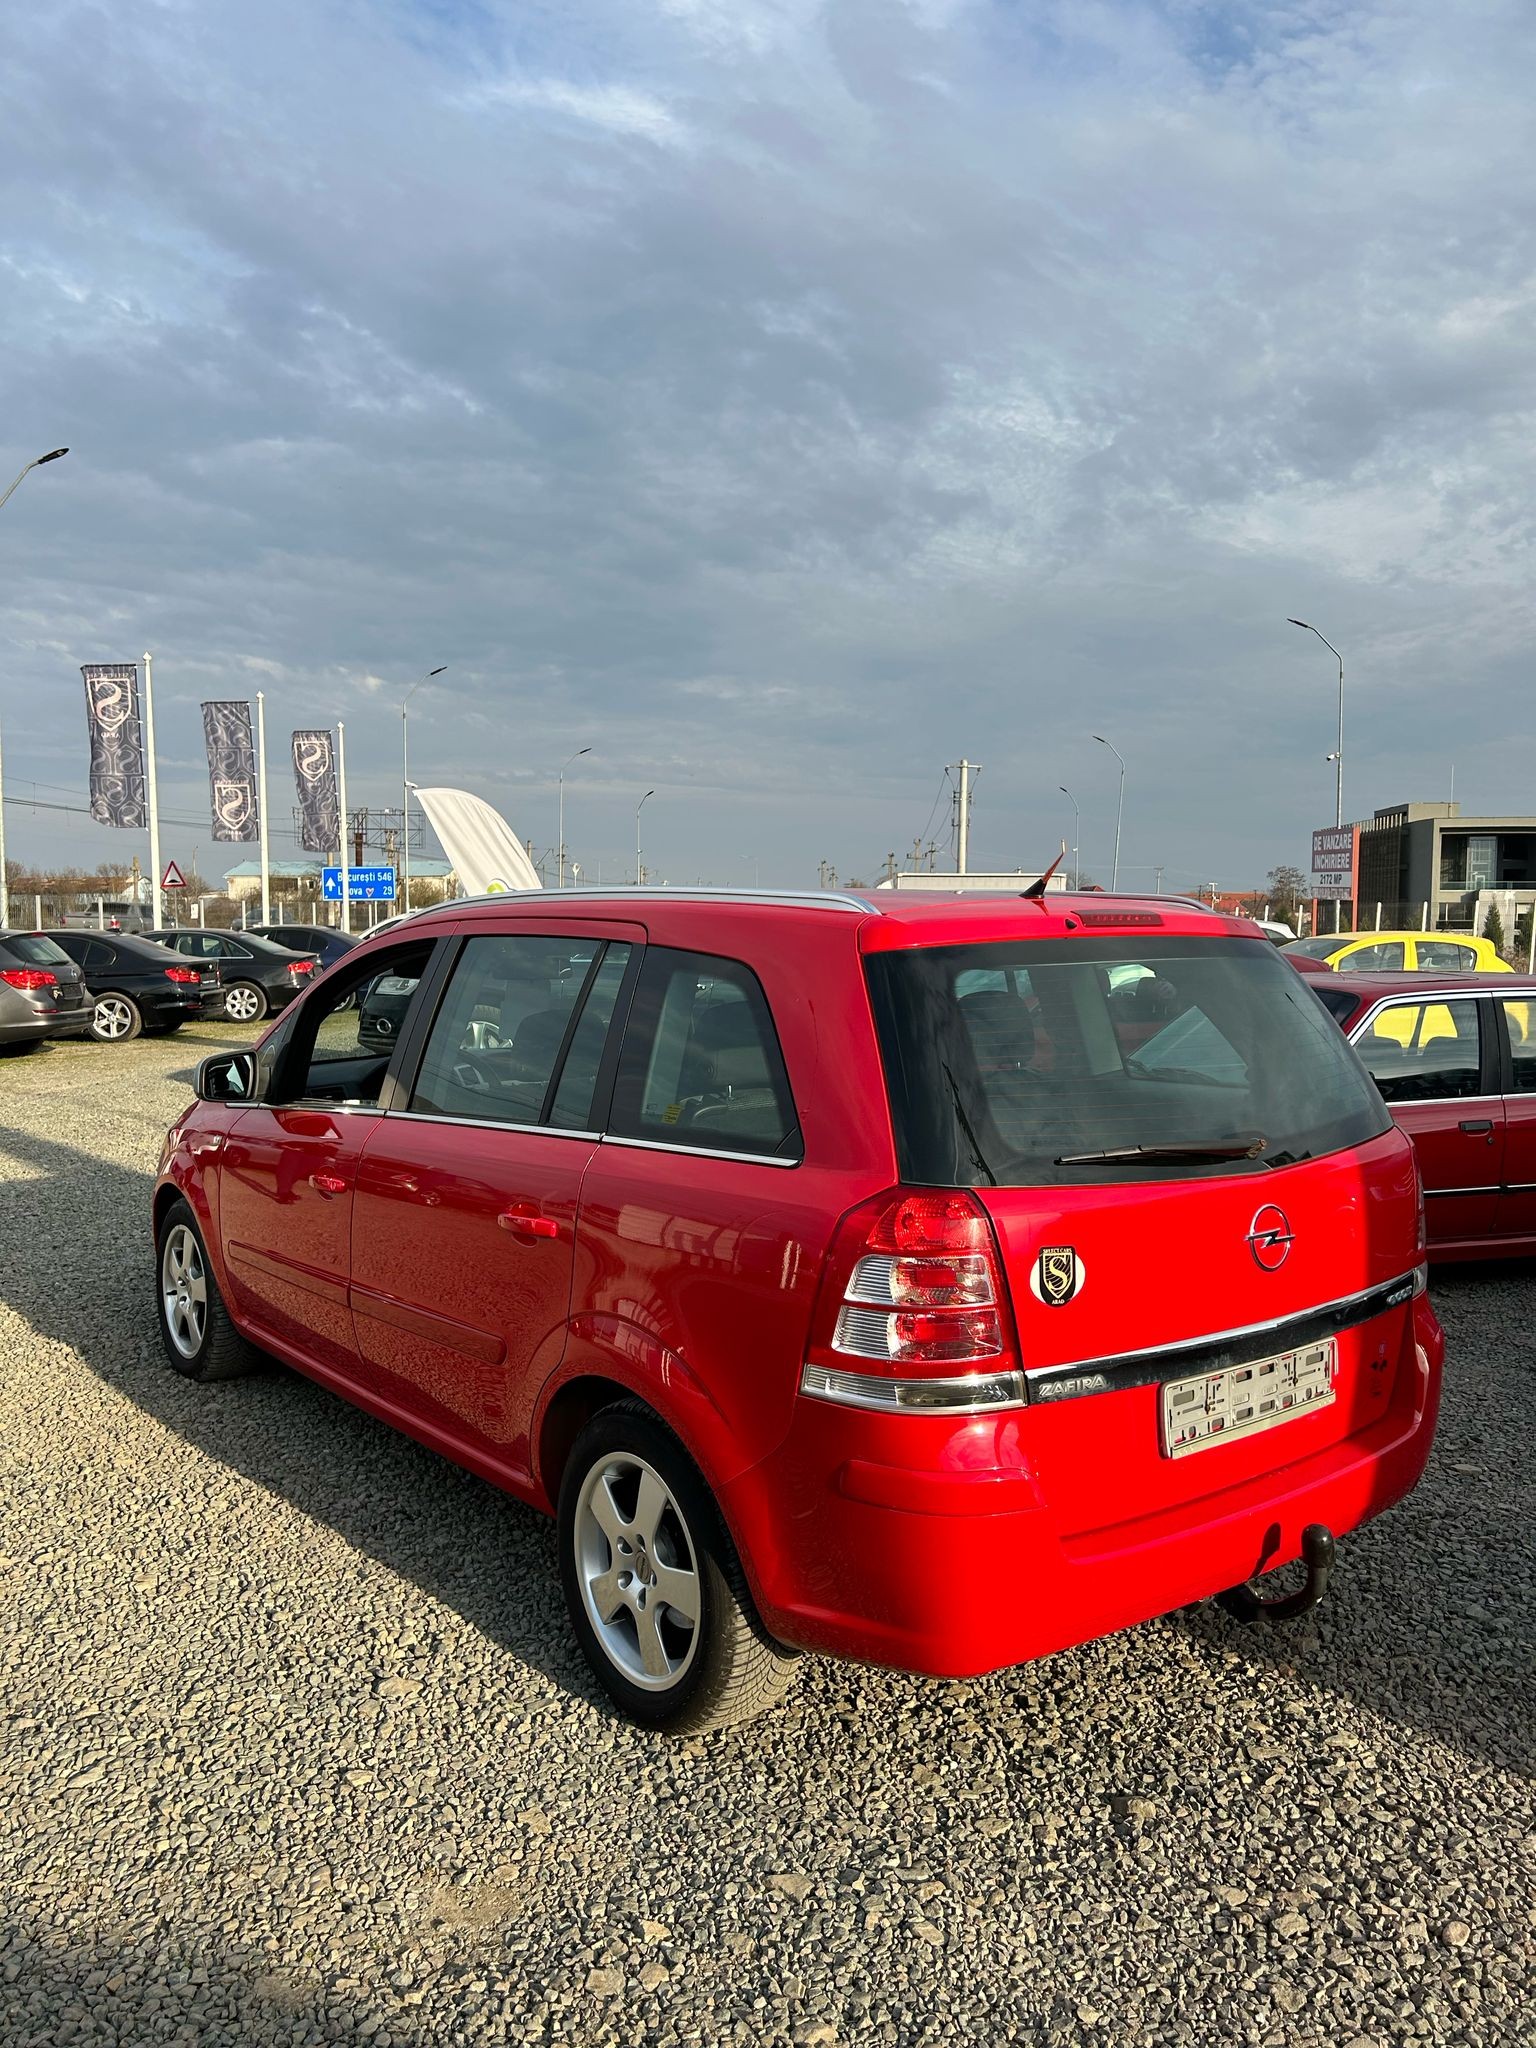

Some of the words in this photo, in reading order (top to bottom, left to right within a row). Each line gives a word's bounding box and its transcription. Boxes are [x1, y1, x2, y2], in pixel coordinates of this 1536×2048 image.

[1313, 836, 1322, 851] DE
[1322, 832, 1352, 850] VANZARE
[1314, 853, 1350, 869] INCHIRIERE
[337, 871, 376, 883] Bcurești
[377, 871, 392, 882] 546
[1320, 874, 1333, 885] 2172
[1334, 873, 1342, 885] MP
[382, 886, 393, 895] 29
[1038, 1374, 1106, 1398] ZAFIRA
